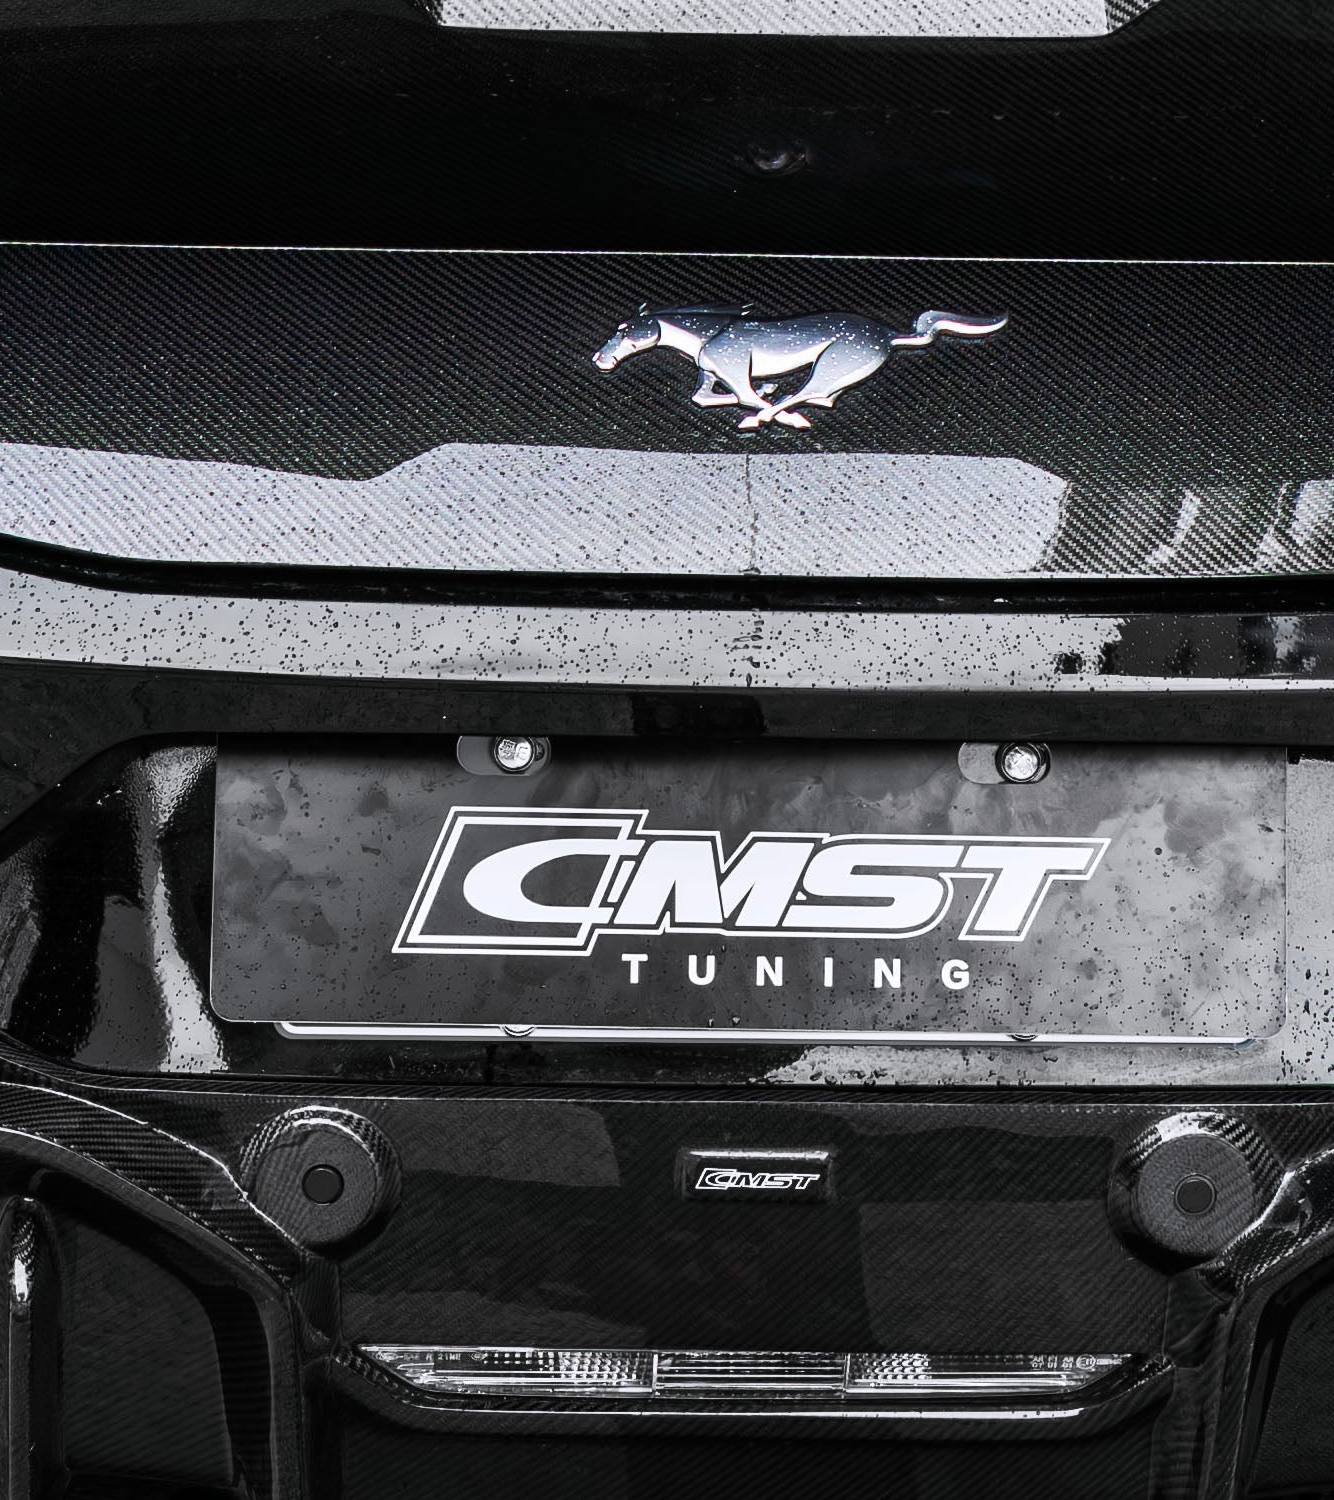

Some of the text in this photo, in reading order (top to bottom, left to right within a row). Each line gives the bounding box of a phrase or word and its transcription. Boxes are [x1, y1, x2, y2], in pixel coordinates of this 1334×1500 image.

[417, 814, 1111, 952] CMST
[621, 954, 971, 990] TUNING
[696, 1168, 821, 1190] CMST
